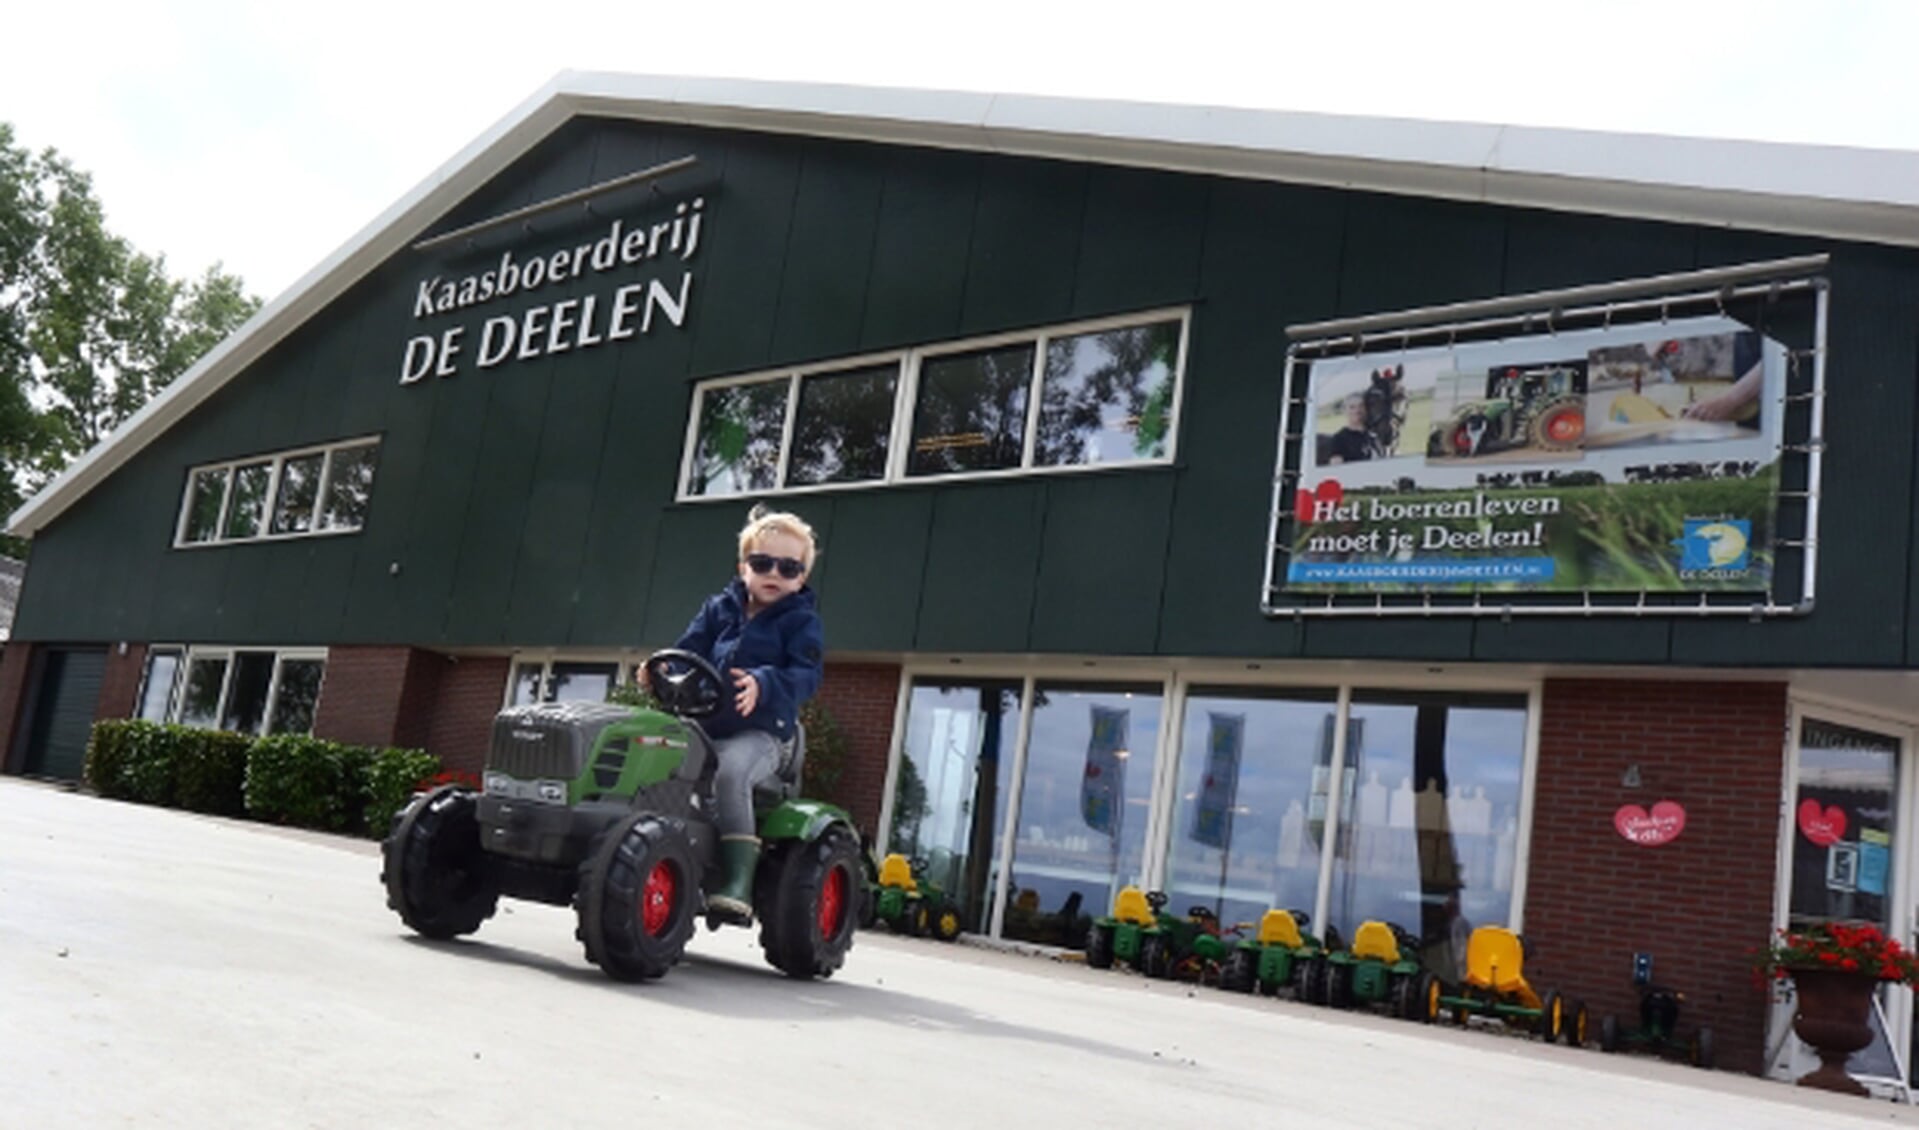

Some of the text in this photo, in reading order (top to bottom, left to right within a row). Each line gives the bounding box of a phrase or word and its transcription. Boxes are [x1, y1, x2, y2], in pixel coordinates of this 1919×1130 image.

[413, 198, 704, 317] Kaasboerderij
[400, 272, 692, 384] DE DEELEN
[1309, 522, 1543, 555] moet je Deelen!
[1312, 492, 1560, 522] Het boerenleven
